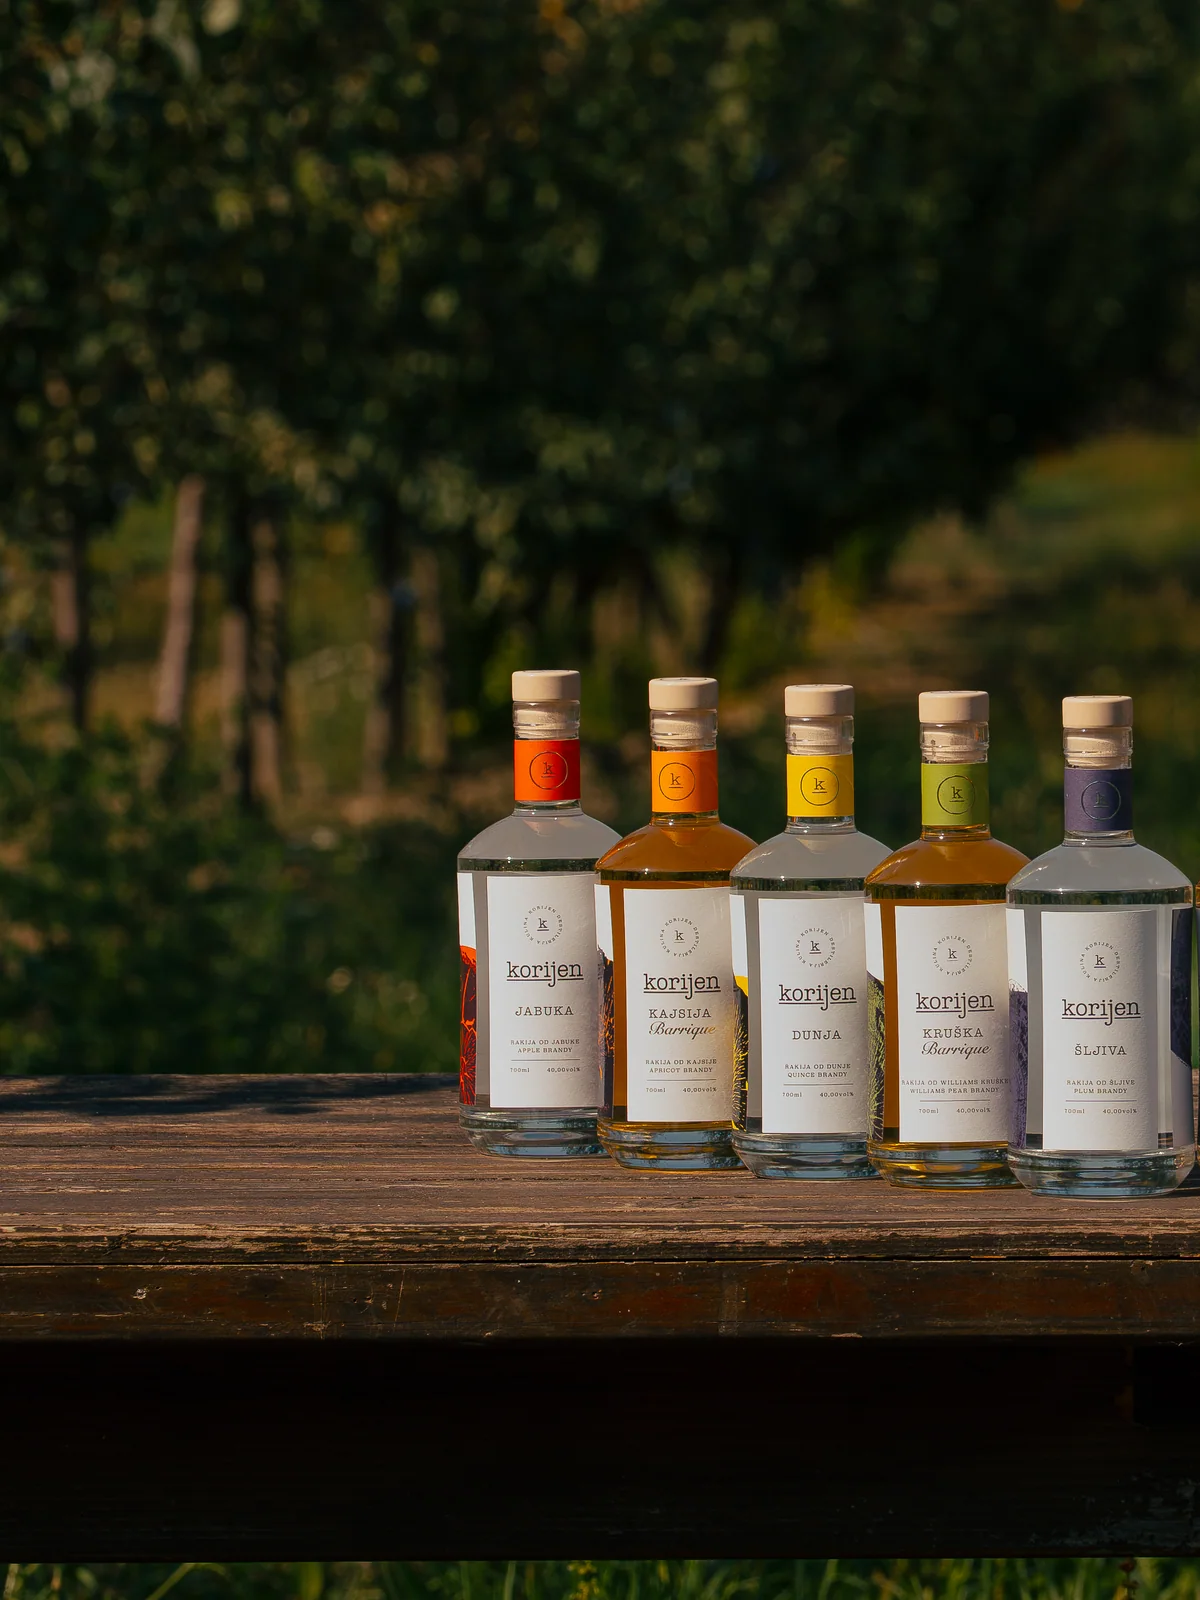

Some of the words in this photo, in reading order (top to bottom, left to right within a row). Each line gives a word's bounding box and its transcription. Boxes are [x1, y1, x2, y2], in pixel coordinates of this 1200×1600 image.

[528, 906, 556, 914] KORIJEN
[538, 918, 547, 928] k
[665, 918, 692, 926] KORIJEN
[675, 930, 684, 940] k
[801, 928, 829, 936] KORIJEN
[938, 936, 966, 944] KORIJEN
[810, 941, 820, 951] k
[1085, 942, 1113, 950] KORIJEN
[948, 948, 957, 959] k
[1095, 955, 1104, 965] k
[506, 961, 584, 987] korijen
[643, 973, 721, 999] korijen
[779, 984, 857, 1011] korijen
[515, 1006, 574, 1016] JABUKA
[916, 993, 995, 1019] korijen
[649, 1009, 711, 1018] KAJSIJA
[1062, 999, 1141, 1026] korijen
[649, 1021, 716, 1040] Barrique
[792, 1030, 841, 1040] DUNJA
[923, 1026, 983, 1038] KRUŠKA
[922, 1041, 991, 1059] Barrique
[1075, 1044, 1127, 1055] ŠLJIVA
